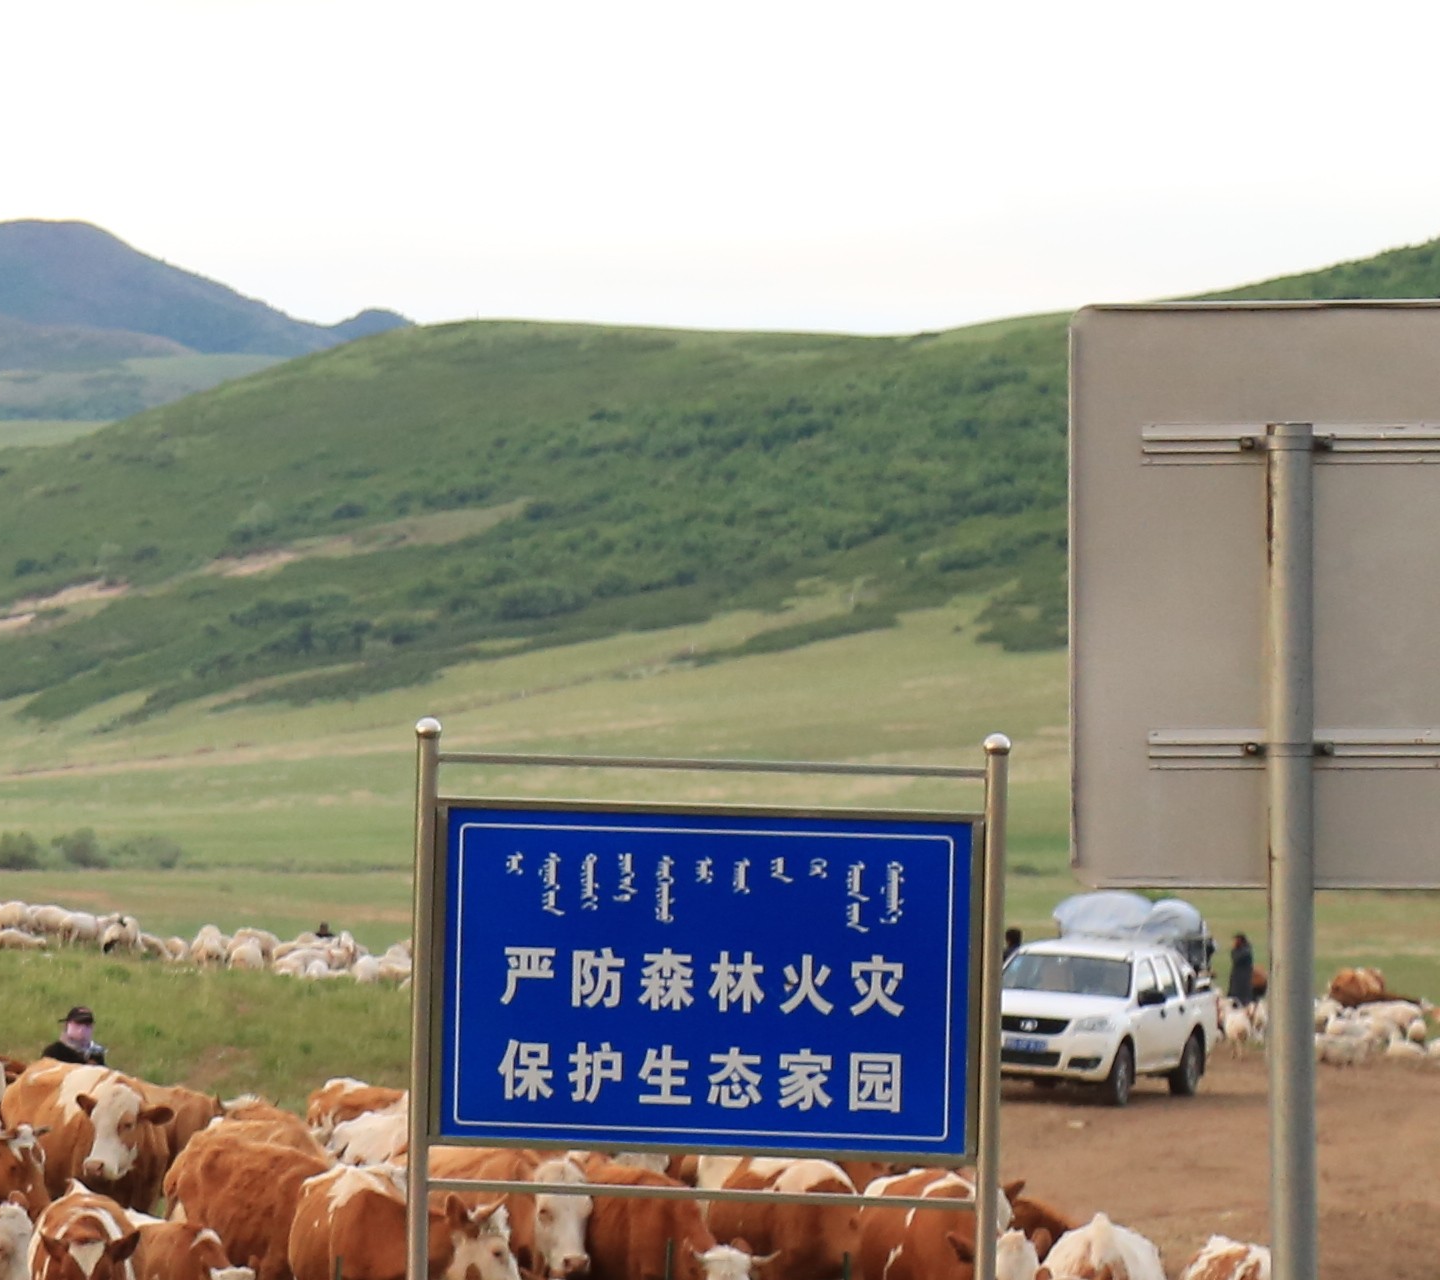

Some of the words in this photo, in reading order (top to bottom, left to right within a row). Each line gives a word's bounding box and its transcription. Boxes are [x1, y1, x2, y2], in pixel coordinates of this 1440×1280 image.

[500, 945, 906, 1018] 严防森林火灾
[498, 1039, 904, 1114] 保护生态家园
